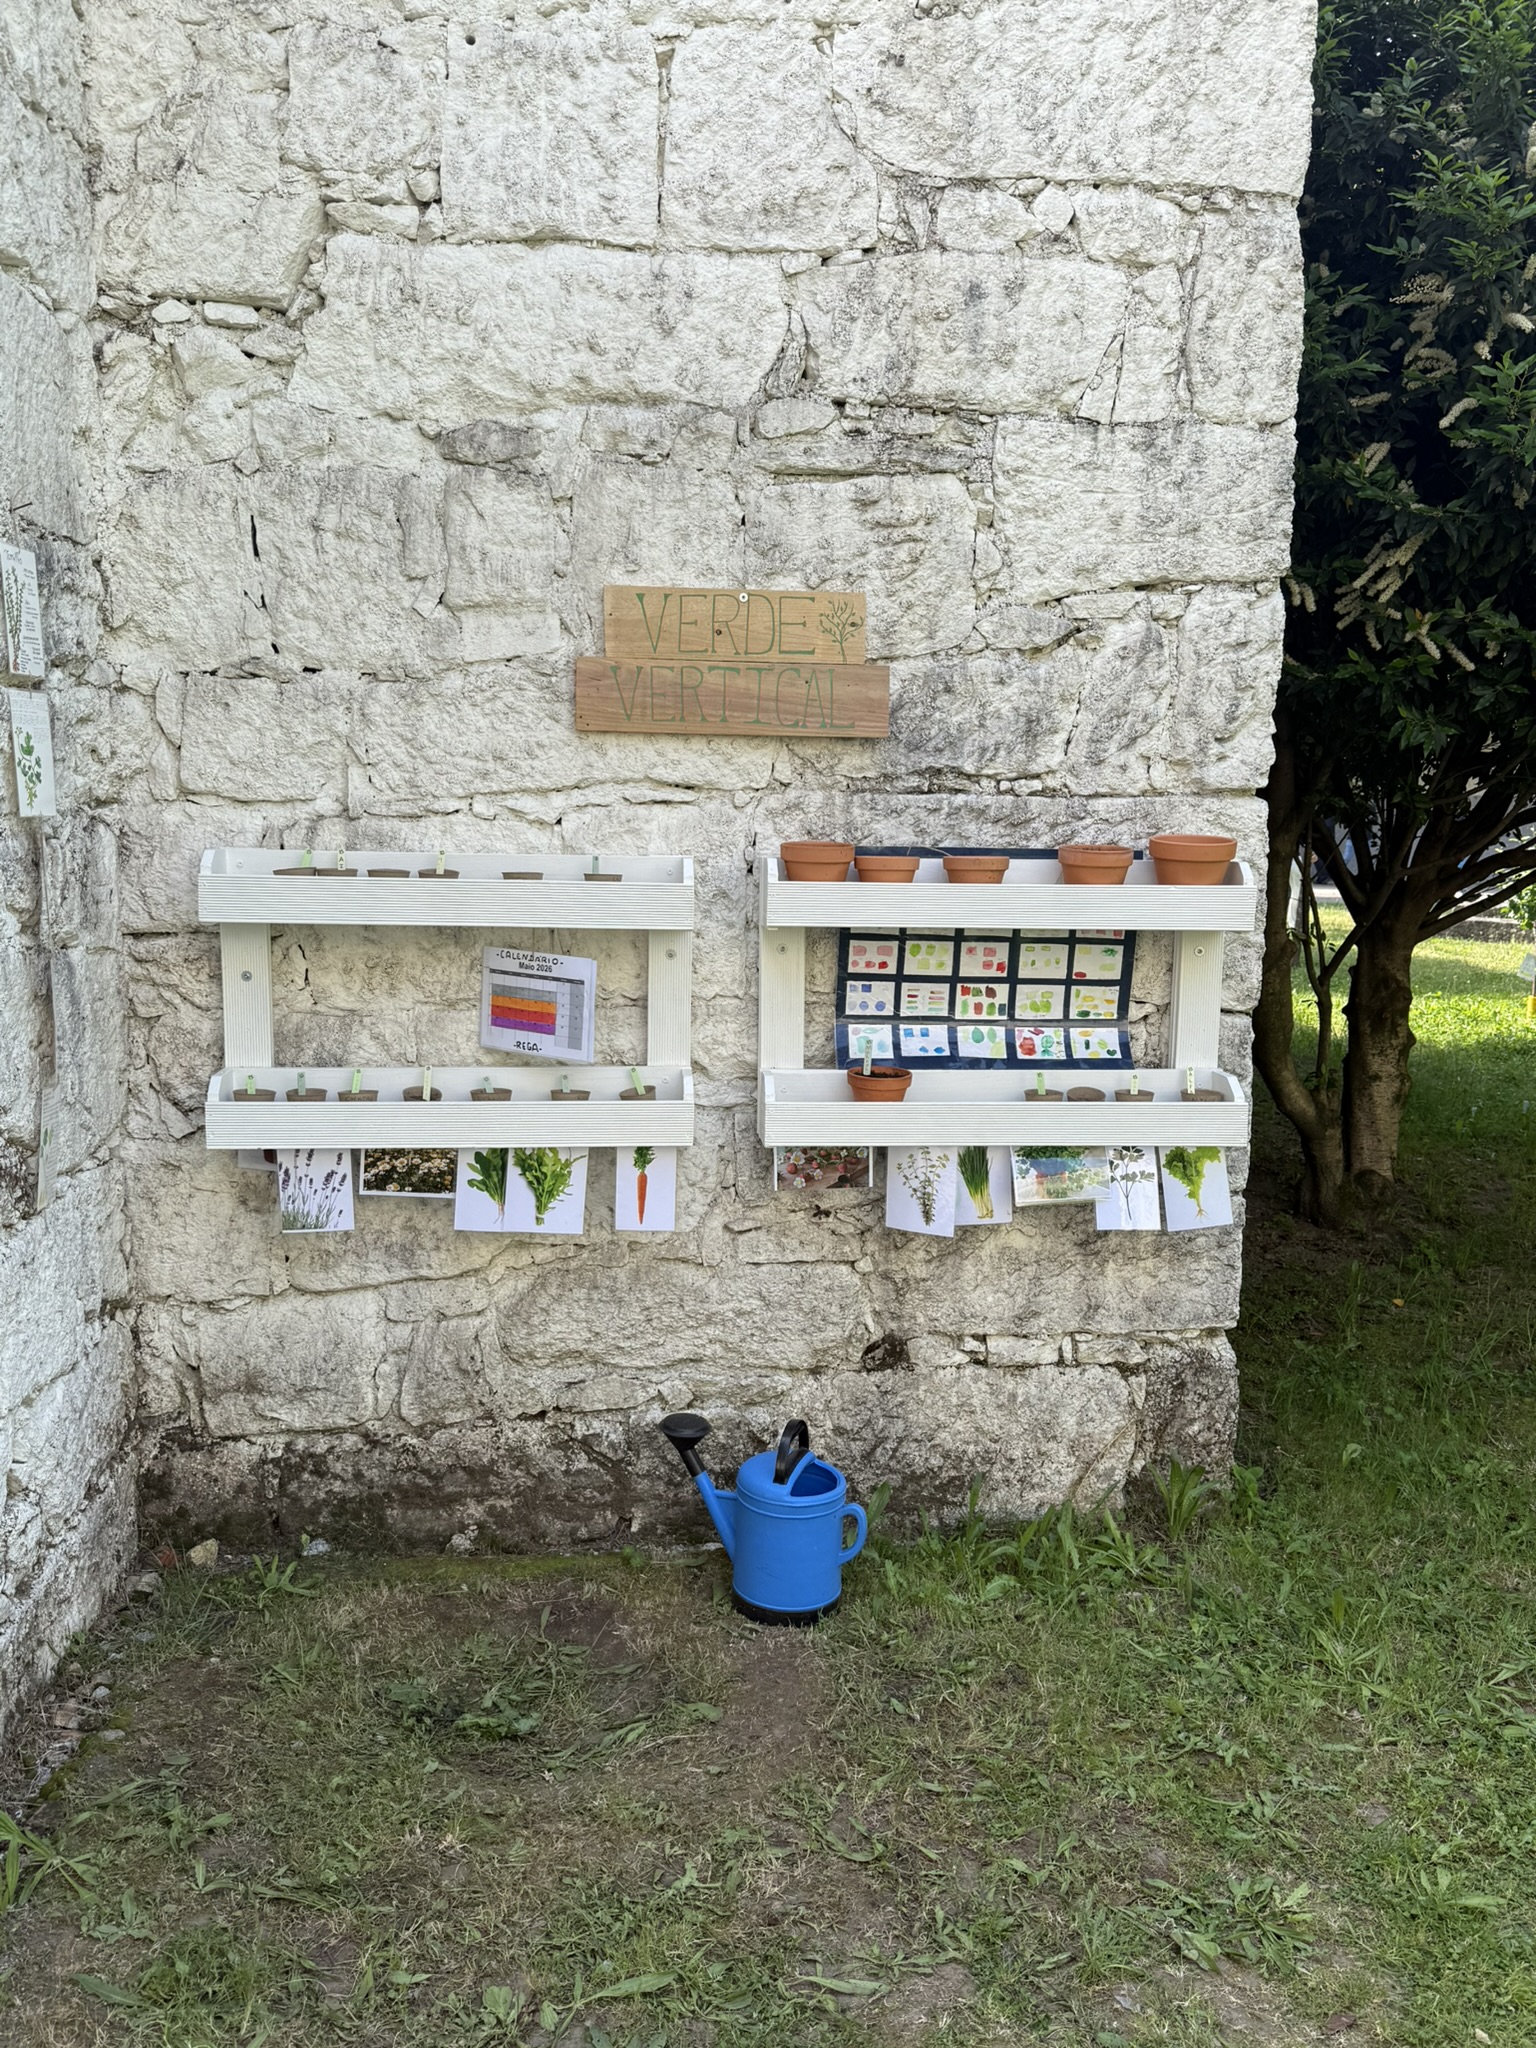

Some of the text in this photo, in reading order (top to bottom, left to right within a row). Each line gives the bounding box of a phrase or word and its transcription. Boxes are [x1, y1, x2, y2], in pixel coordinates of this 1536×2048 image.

[635, 592, 816, 656] VERDE
[609, 665, 855, 729] VERTICAL
[518, 961, 553, 973] Maio 2026
